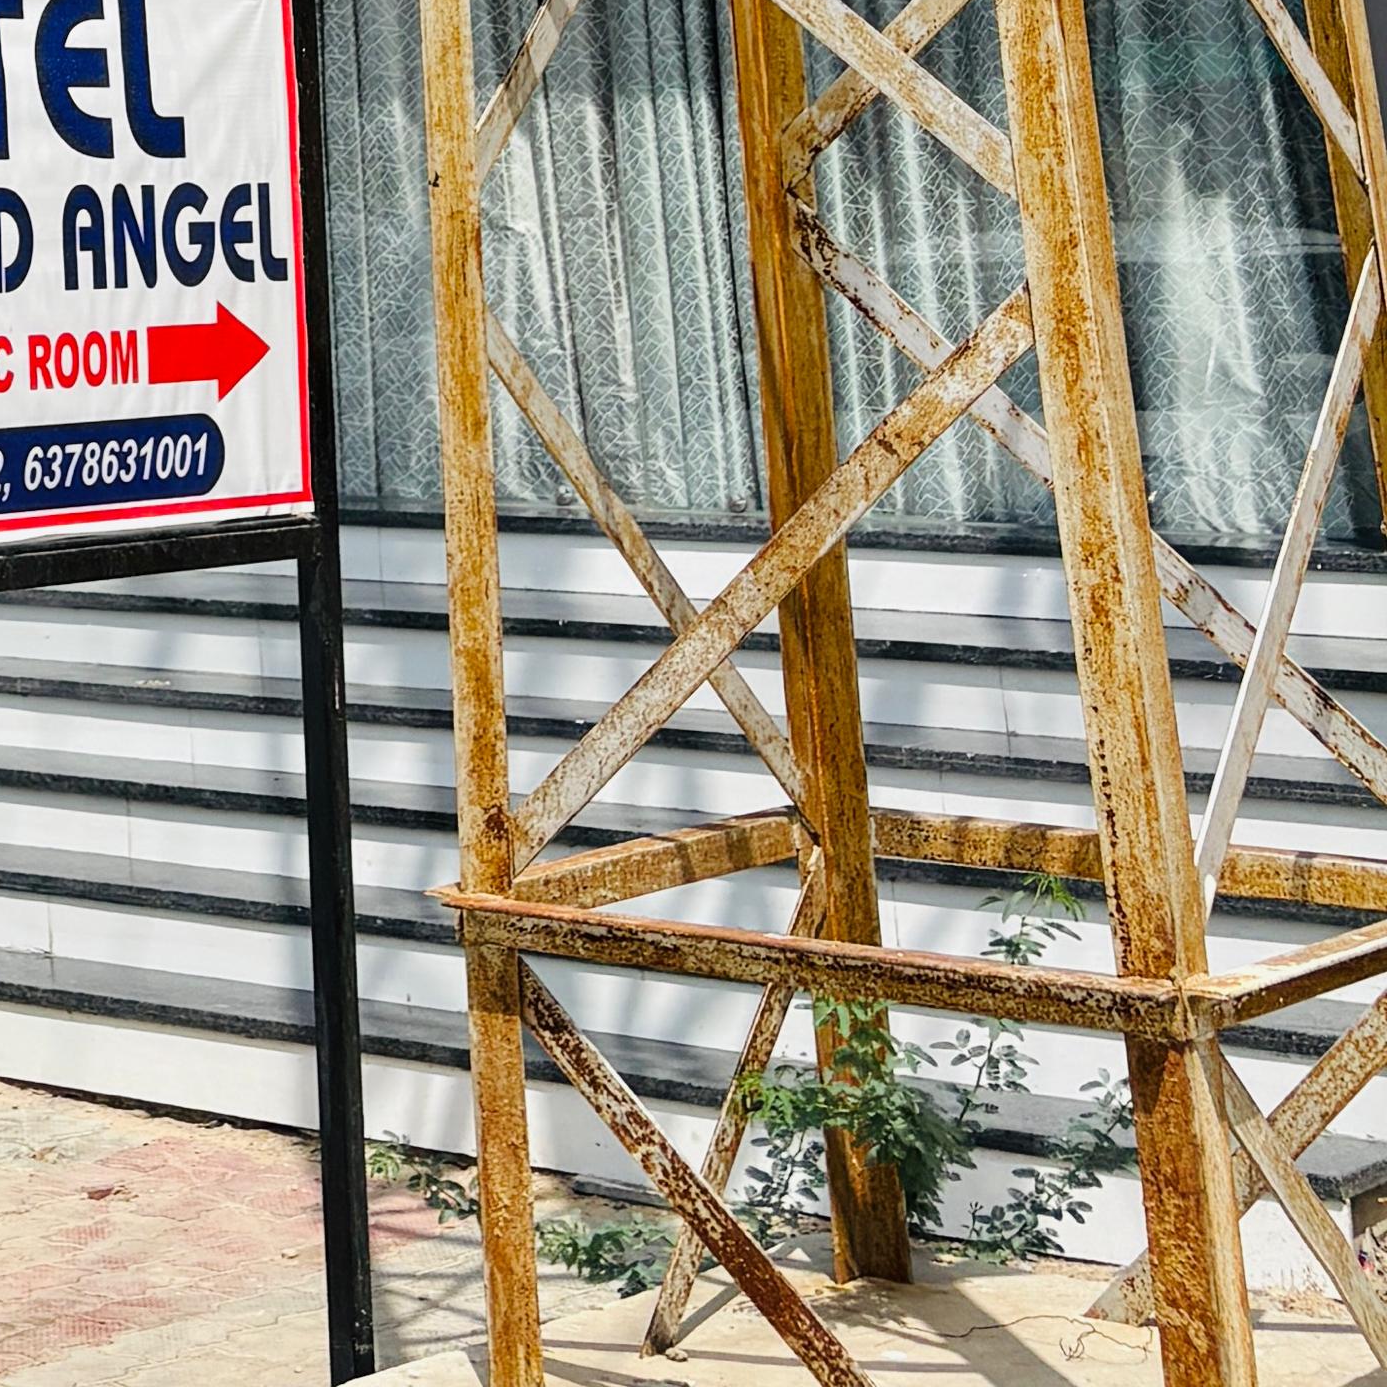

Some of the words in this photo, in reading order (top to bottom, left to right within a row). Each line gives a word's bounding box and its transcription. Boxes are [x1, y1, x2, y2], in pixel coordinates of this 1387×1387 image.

[62, 182, 289, 291] ANGEL
[30, 329, 139, 389] ROOM
[23, 433, 209, 490] 6378631001
